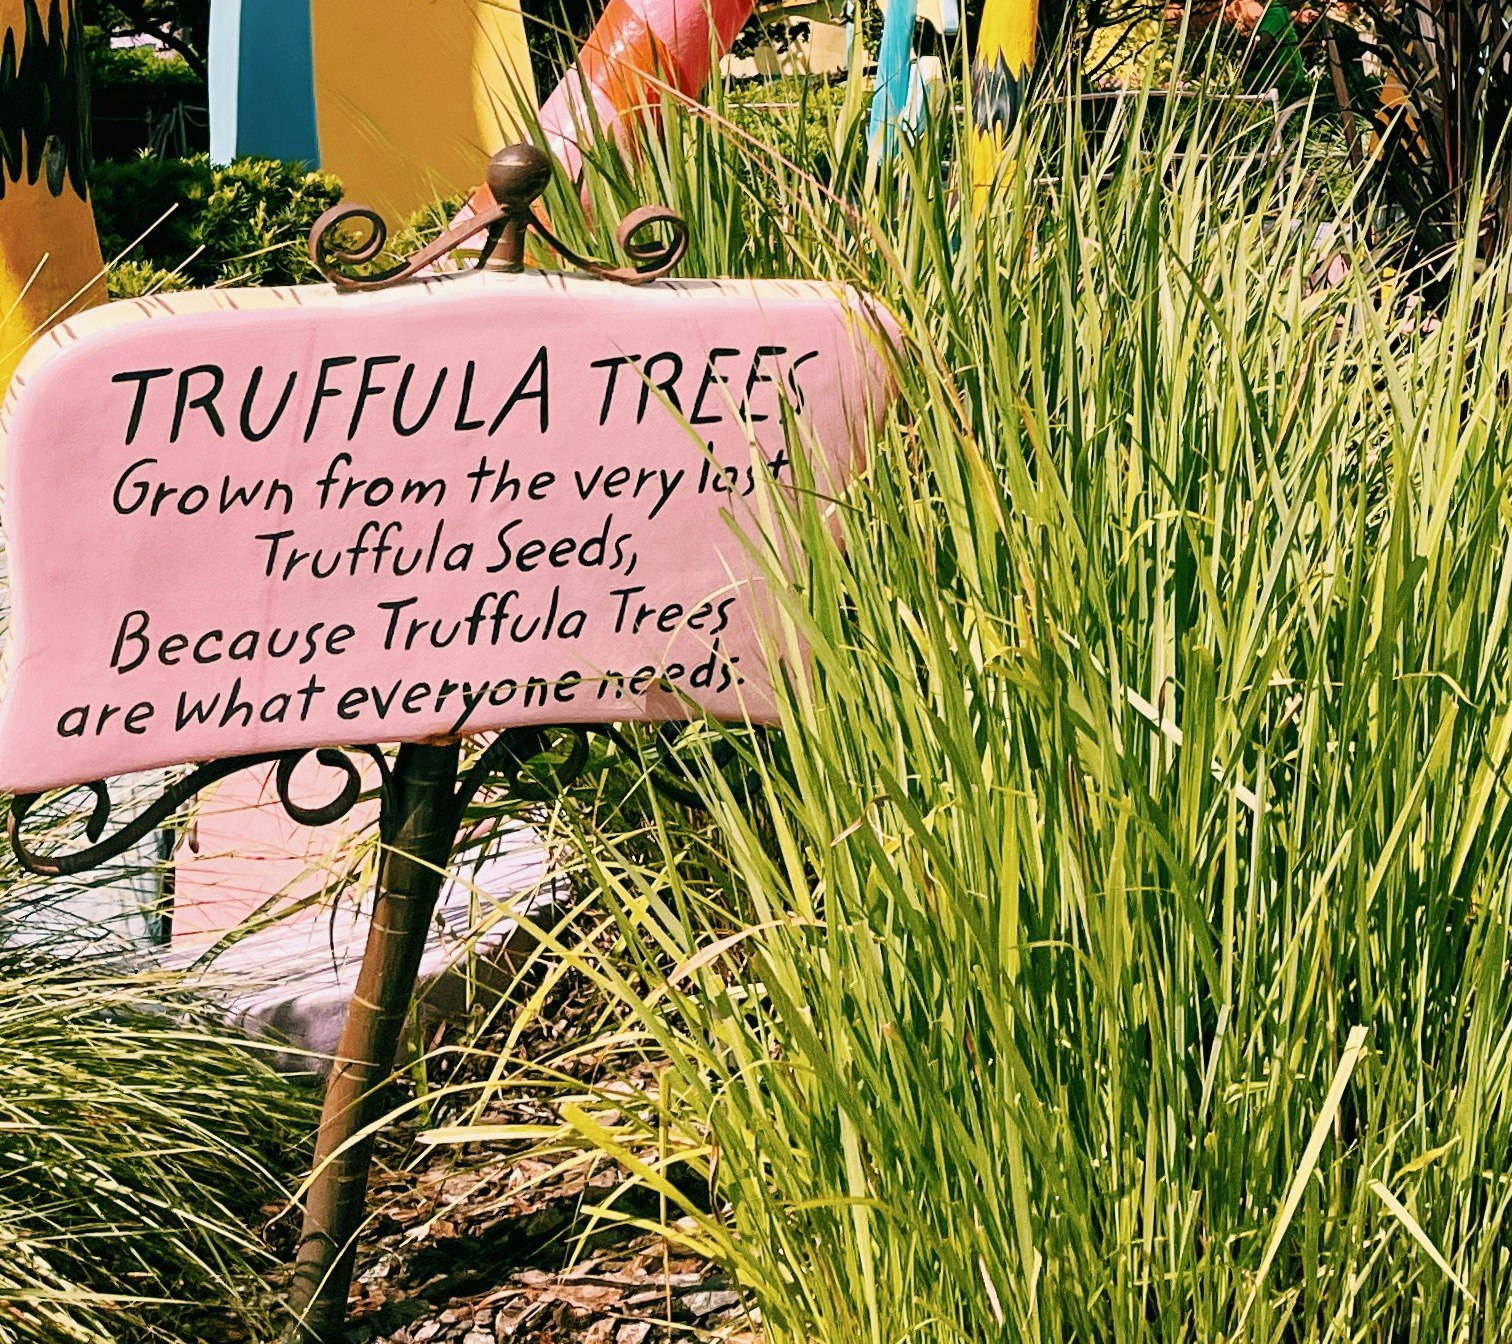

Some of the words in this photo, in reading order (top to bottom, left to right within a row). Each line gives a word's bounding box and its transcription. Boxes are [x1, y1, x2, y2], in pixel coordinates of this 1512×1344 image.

[112, 346, 549, 445] TRUFFULA
[590, 346, 819, 425] TREES
[113, 458, 293, 516] Grown
[316, 453, 447, 509] from
[467, 455, 556, 503] the
[575, 465, 685, 520] very
[698, 441, 791, 496] last
[254, 518, 473, 581] Truffula
[487, 514, 637, 576] Seeds,
[110, 610, 356, 674] Because
[378, 585, 587, 654] Truffula
[609, 585, 736, 635] Trees
[57, 695, 155, 738] are
[175, 675, 325, 732] what
[338, 670, 582, 731] everyone
[597, 637, 746, 700] needs.
